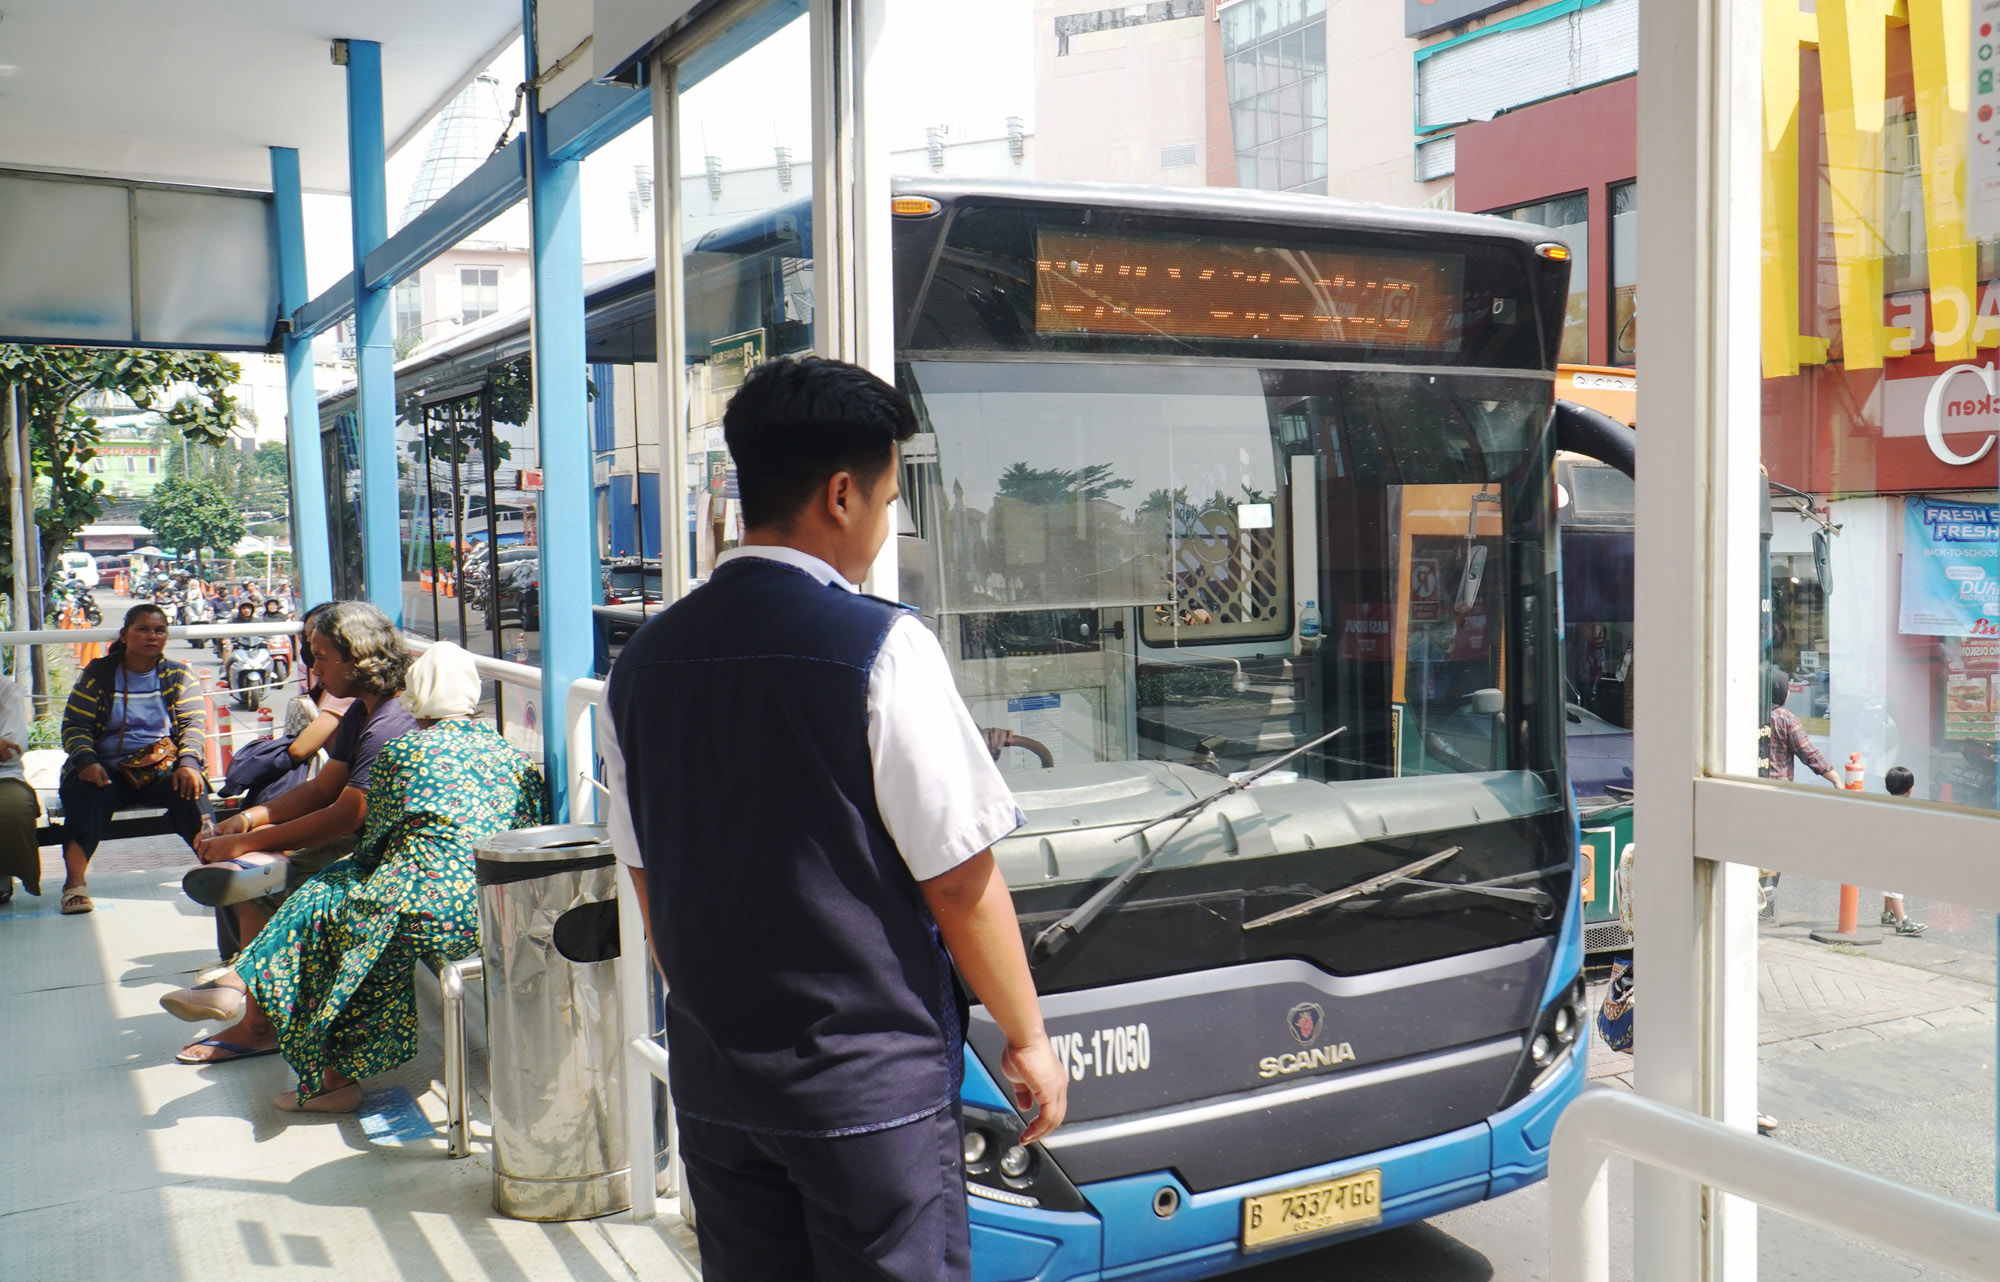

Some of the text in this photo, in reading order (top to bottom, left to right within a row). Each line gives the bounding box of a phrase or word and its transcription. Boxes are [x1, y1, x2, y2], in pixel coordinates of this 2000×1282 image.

[1927, 508, 1987, 521] FRESH
[1937, 525, 1999, 537] FRESH
[1923, 548, 1999, 557] BACK-TO-SCHOOL
[1258, 1042, 1356, 1078] SCANIA
[1251, 1204, 1263, 1230] B
[1281, 1188, 1333, 1223] 7337
